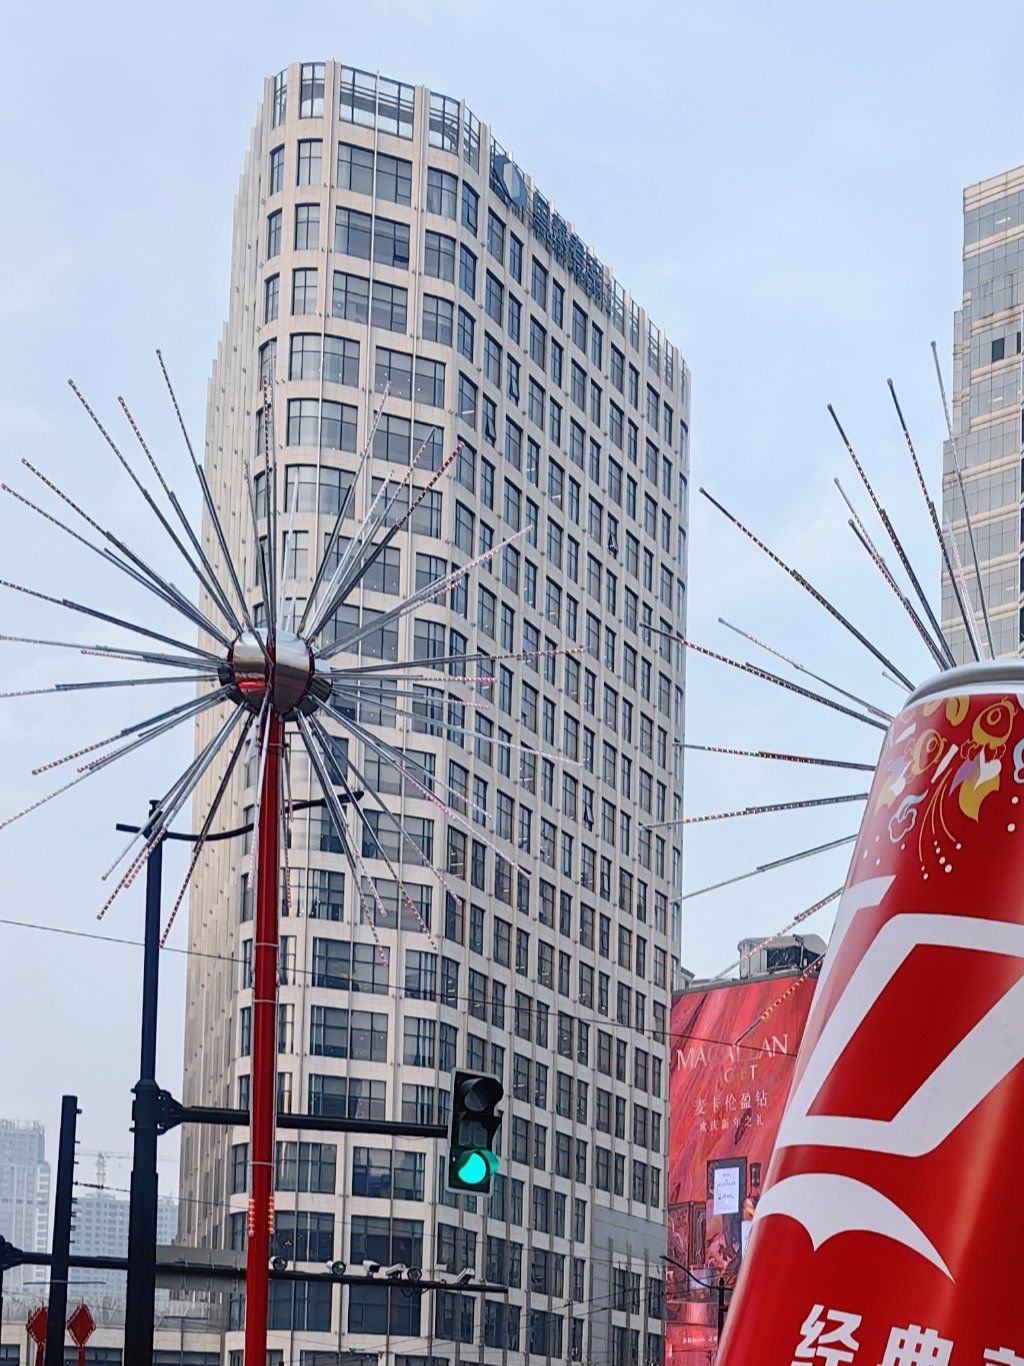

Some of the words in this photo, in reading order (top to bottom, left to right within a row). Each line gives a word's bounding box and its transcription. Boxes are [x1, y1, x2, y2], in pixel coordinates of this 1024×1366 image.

[694, 1090, 767, 1115] 麦卡伦盈钻
